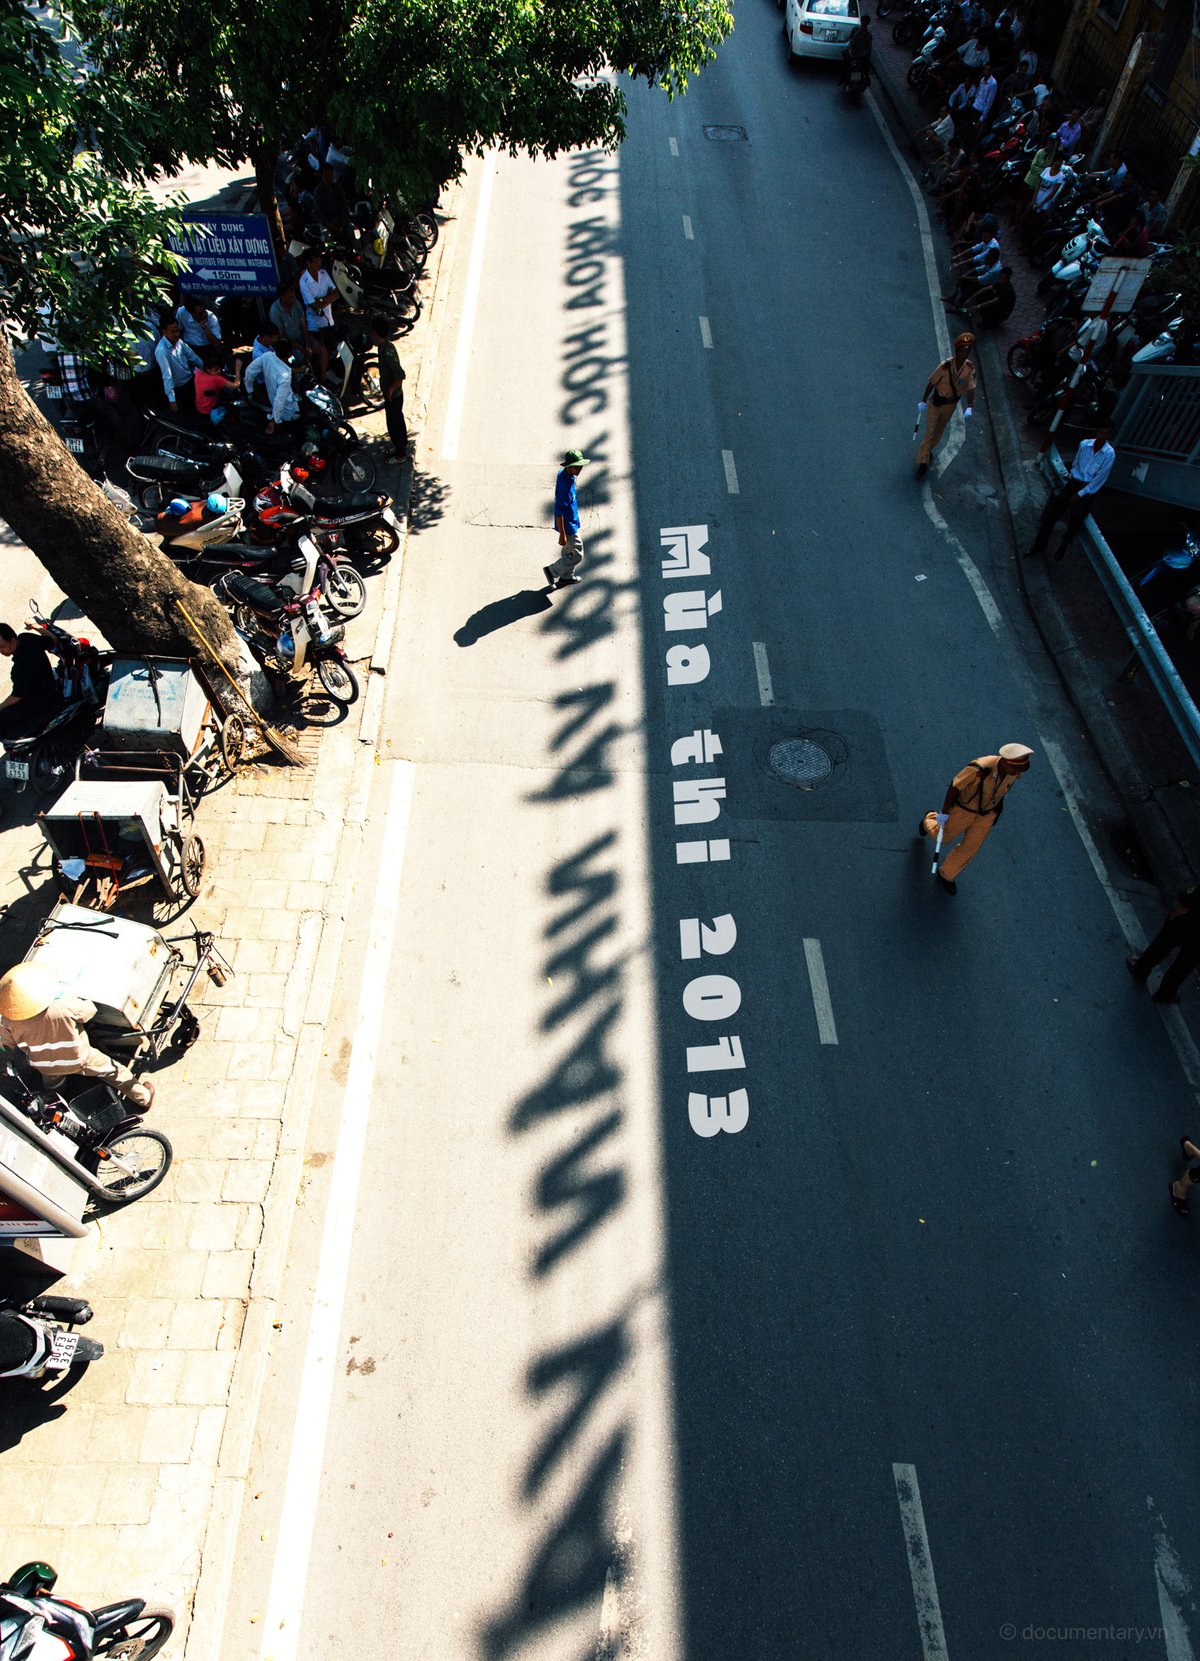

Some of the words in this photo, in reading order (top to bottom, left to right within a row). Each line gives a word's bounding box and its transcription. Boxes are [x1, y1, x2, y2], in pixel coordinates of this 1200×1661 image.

[207, 235, 226, 255] LIỆU
[227, 235, 244, 254] XÂY
[245, 238, 269, 256] DỰNG
[212, 271, 240, 279] 150m
[60, 1338, 76, 1363] 3295
